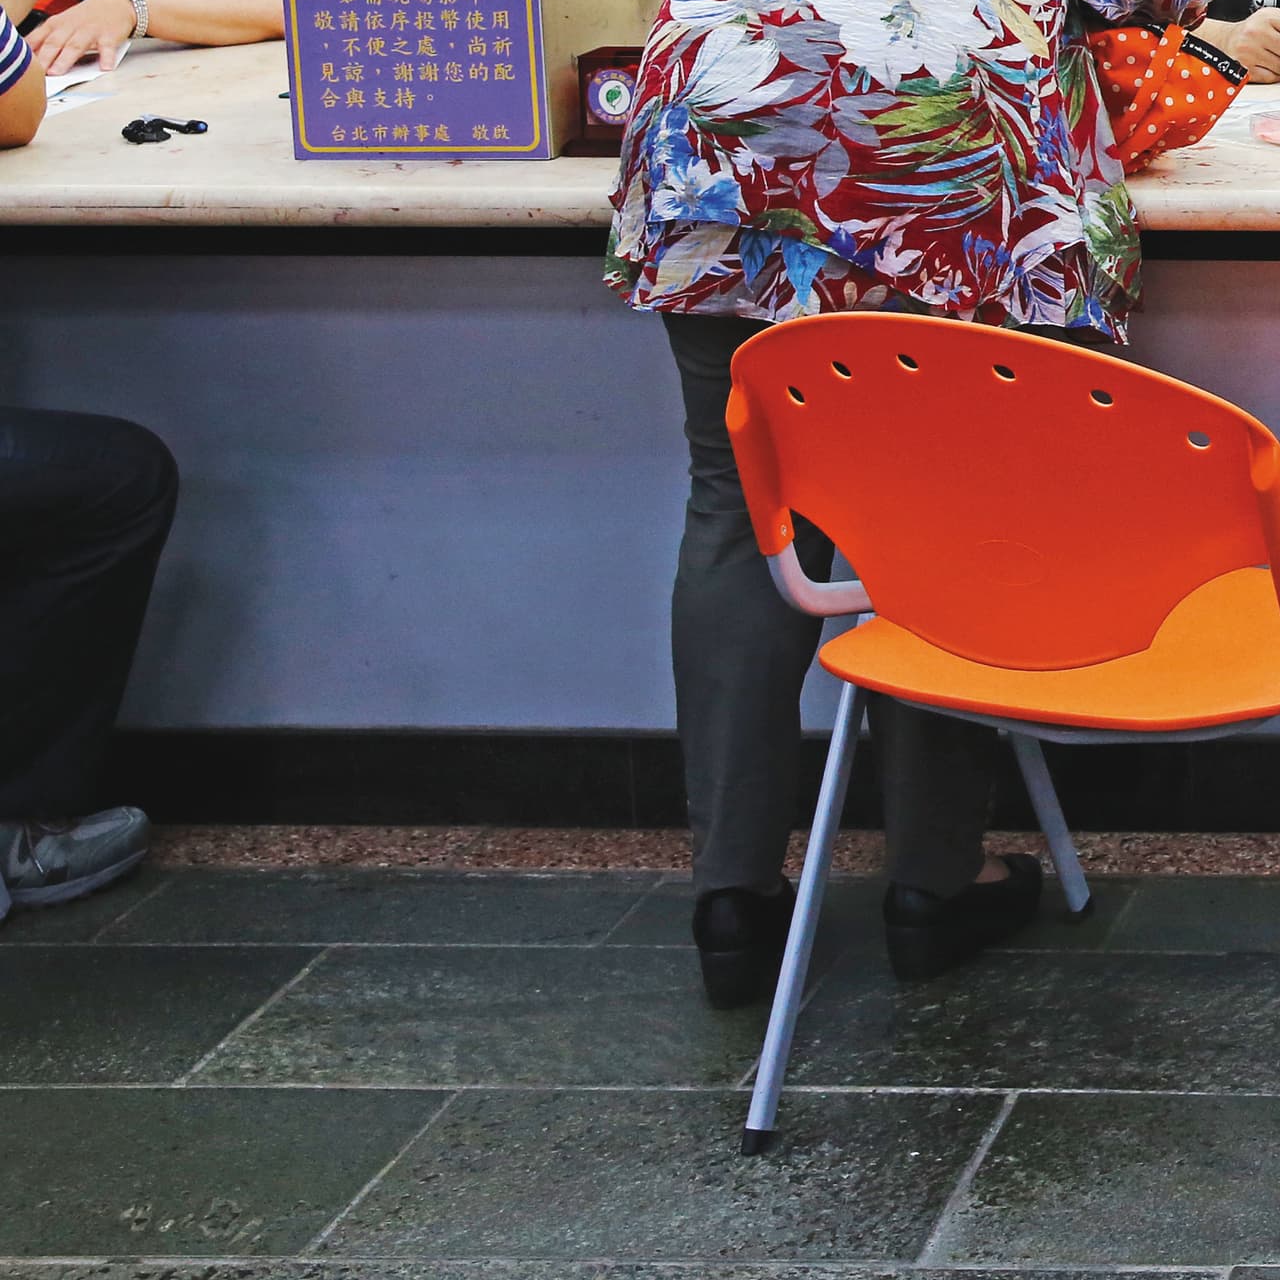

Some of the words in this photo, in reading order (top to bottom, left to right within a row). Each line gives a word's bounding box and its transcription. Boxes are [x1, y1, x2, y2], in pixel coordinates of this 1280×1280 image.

[314, 10, 510, 32] 敬請依序投幣使用
[331, 124, 453, 142] 台北市辦事處
[472, 125, 511, 141] 敬啟
